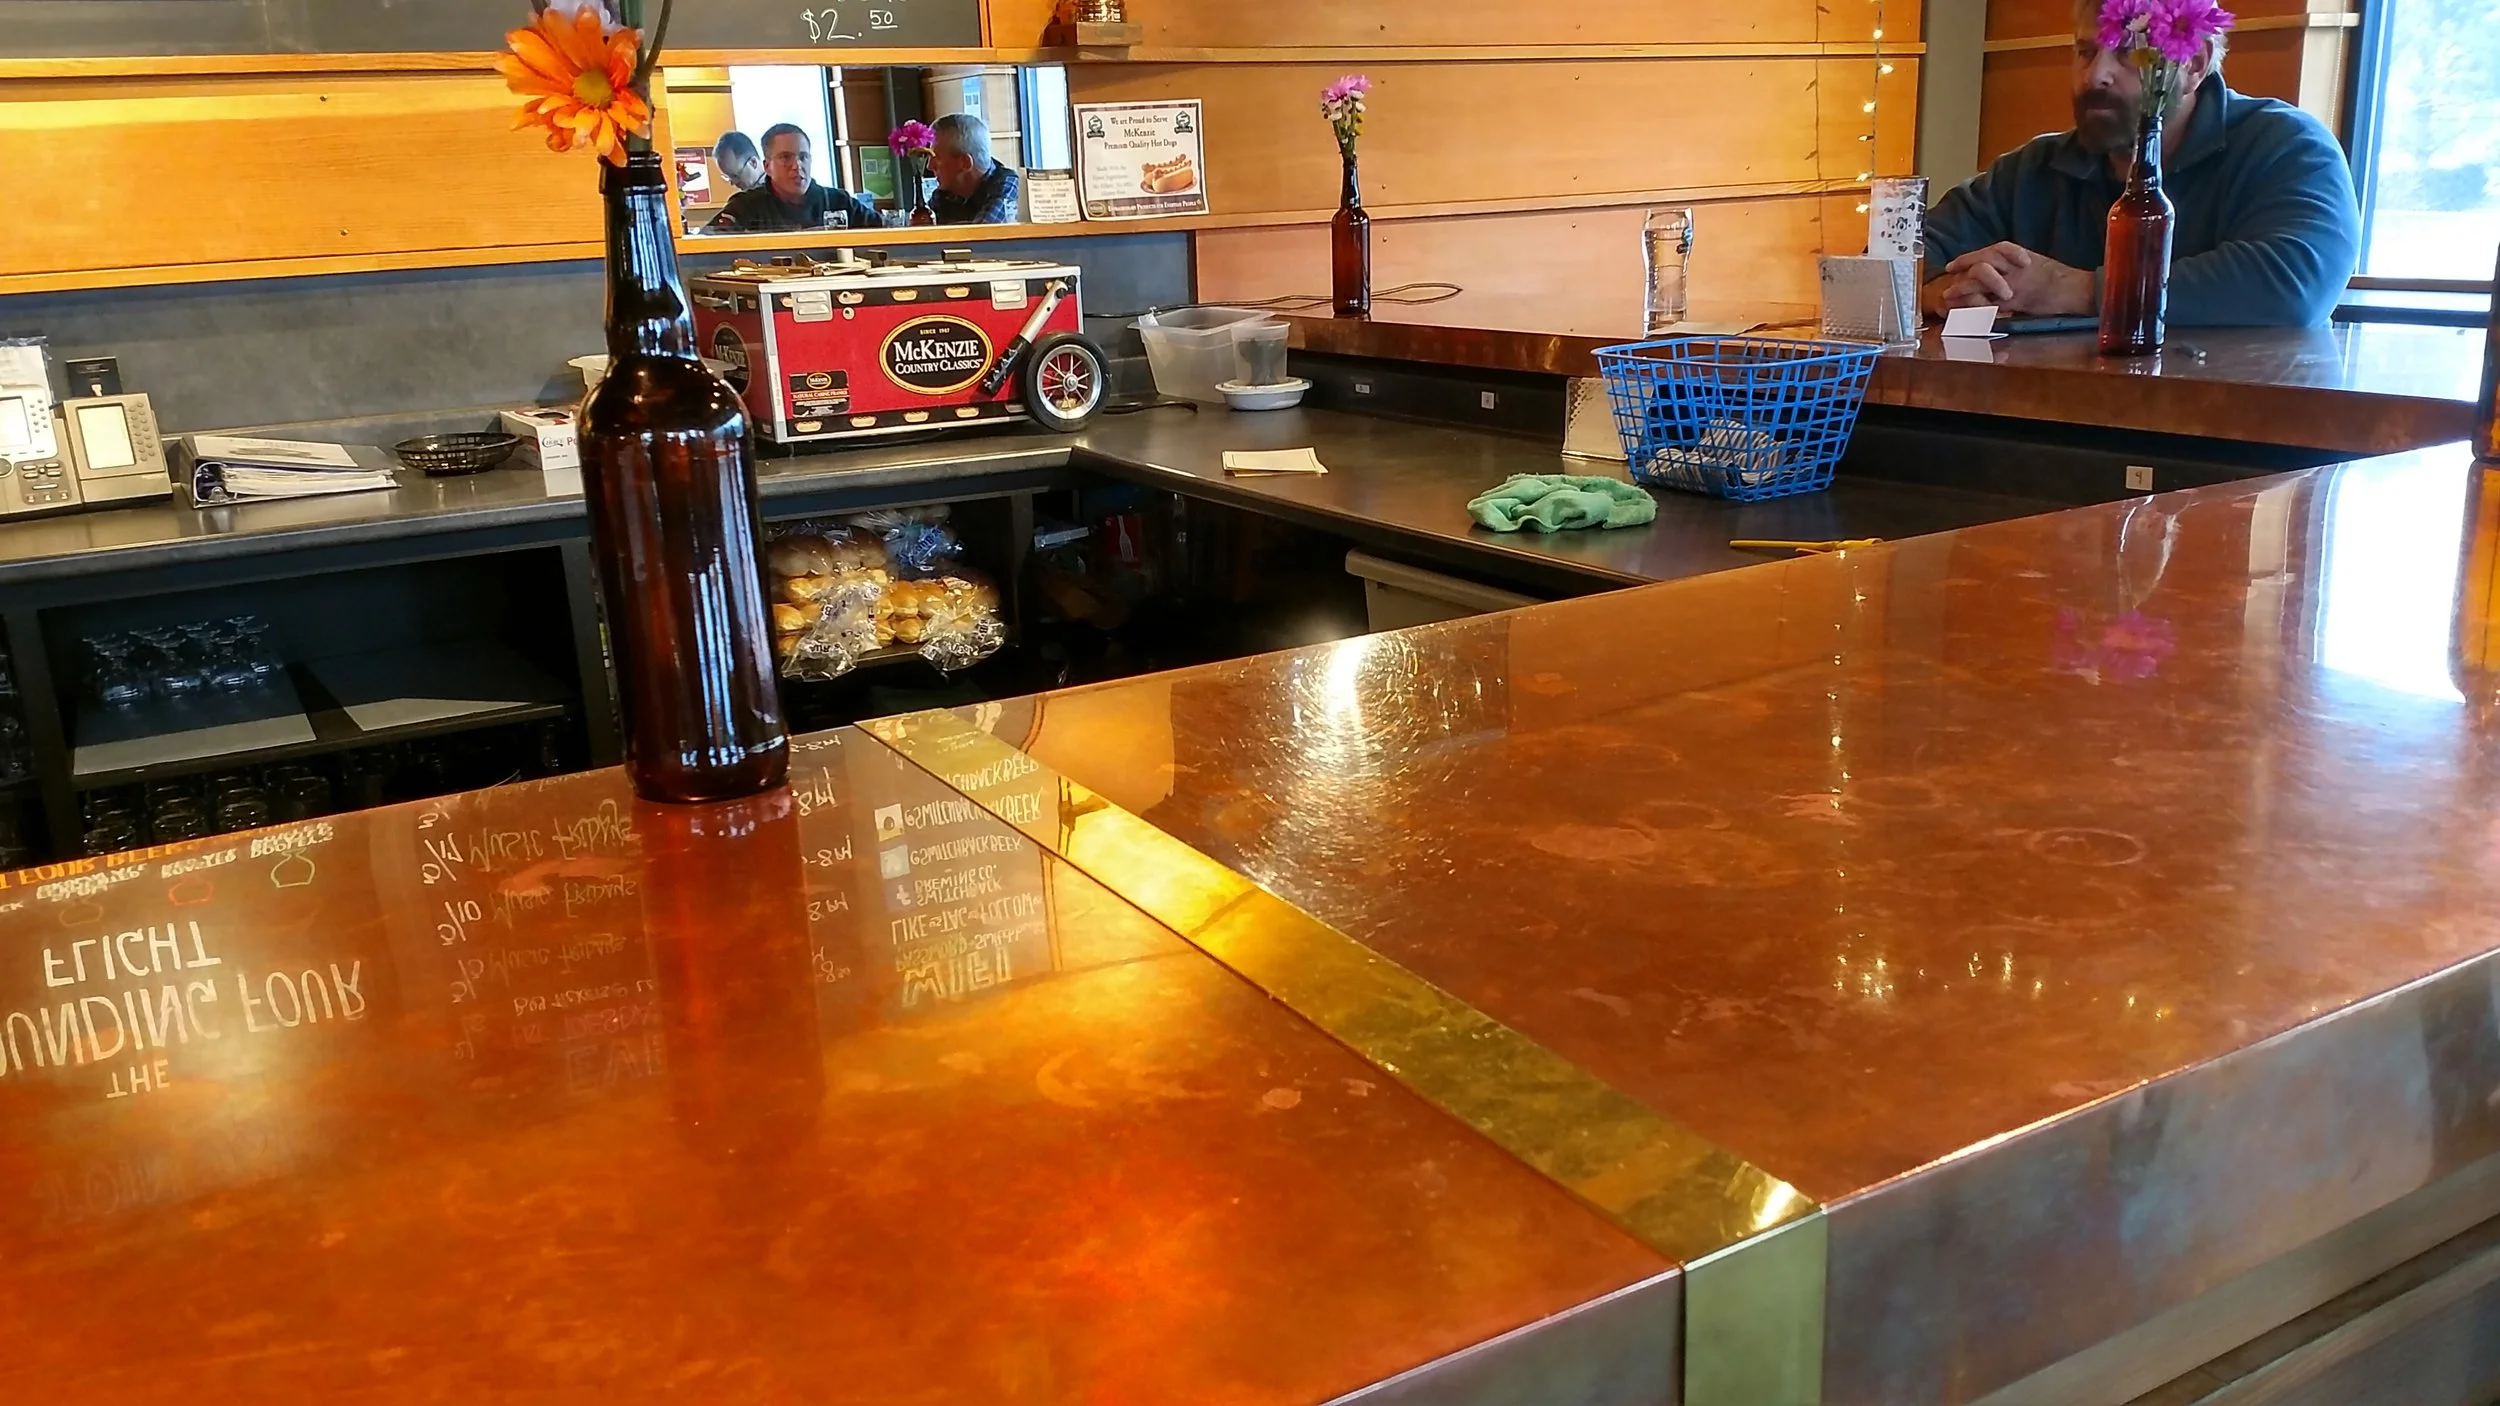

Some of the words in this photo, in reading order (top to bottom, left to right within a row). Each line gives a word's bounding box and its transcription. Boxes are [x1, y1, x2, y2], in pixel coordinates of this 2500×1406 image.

[1128, 116, 1145, 124] Proud
[1153, 115, 1168, 123] Serve
[1123, 128, 1156, 137] McKenzie
[1128, 140, 1149, 150] Quality
[1151, 139, 1162, 147] Hot
[1163, 138, 1177, 148] Dogs
[893, 339, 979, 361] McKENZIE
[895, 362, 938, 375] COUNTRY
